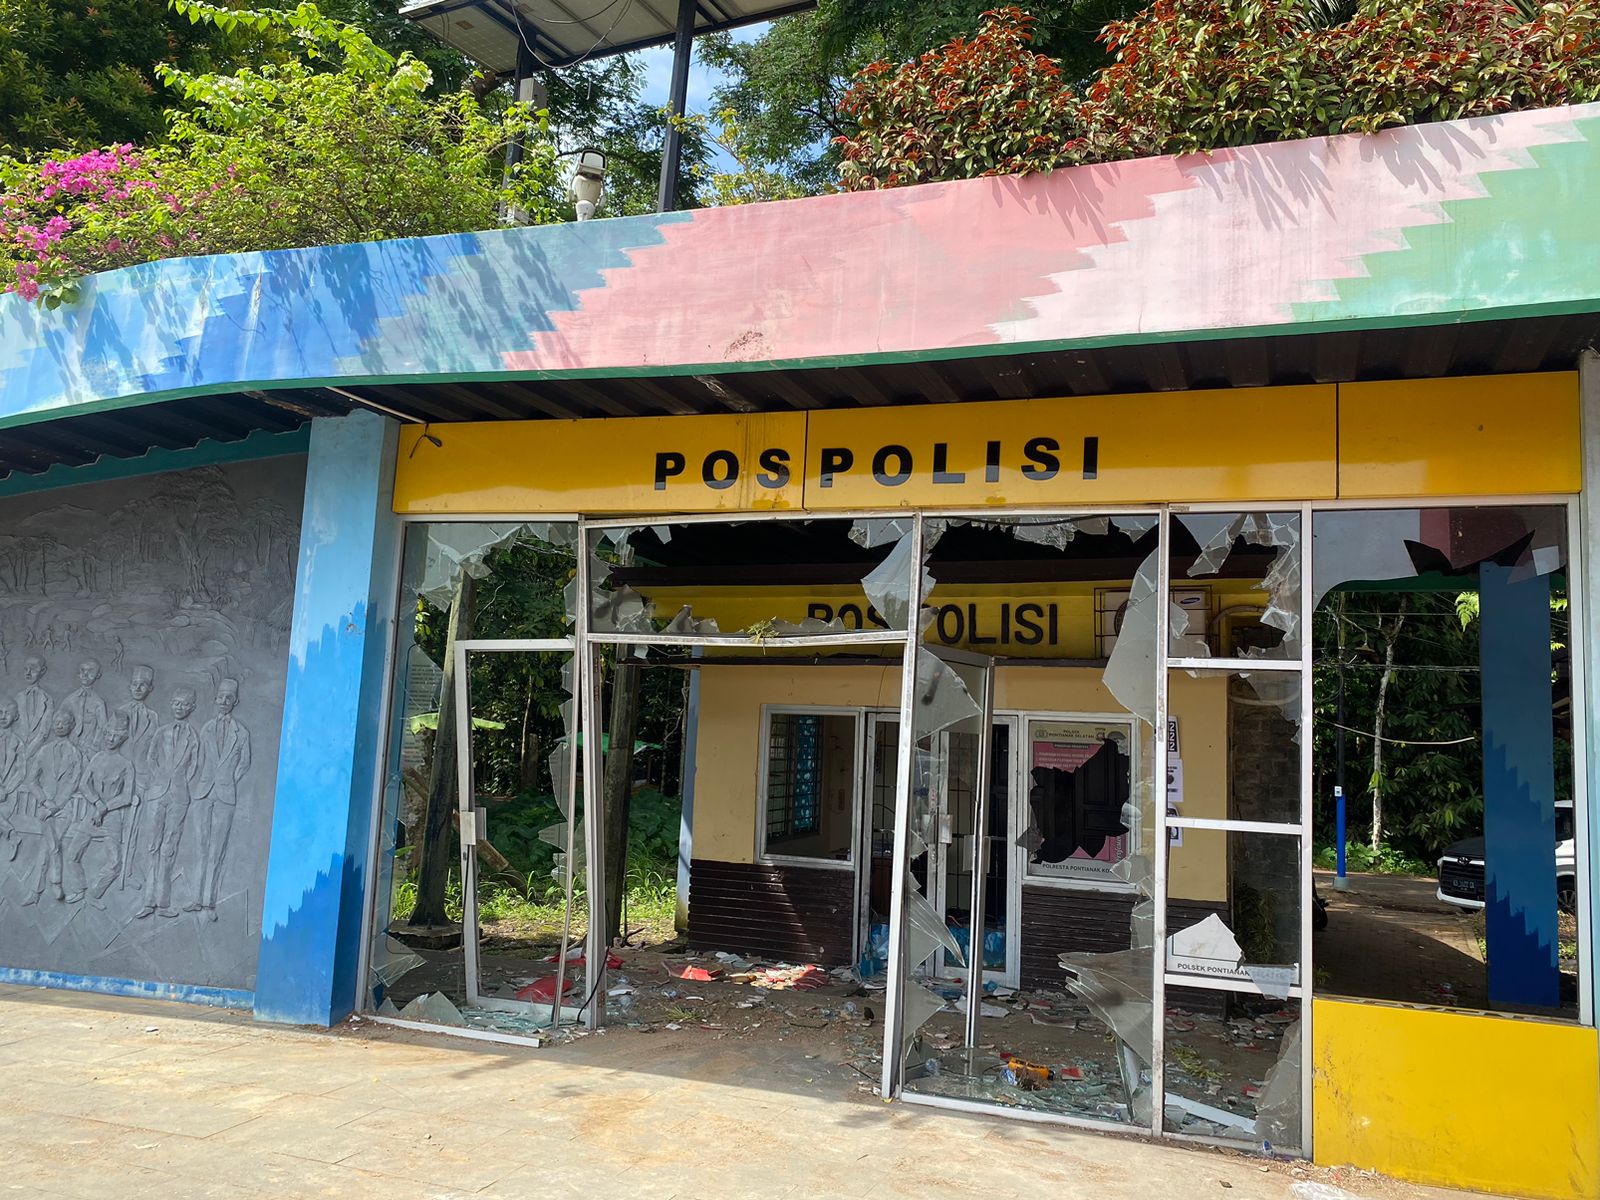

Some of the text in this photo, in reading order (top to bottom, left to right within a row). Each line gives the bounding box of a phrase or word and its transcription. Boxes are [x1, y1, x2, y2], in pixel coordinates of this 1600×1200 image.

[653, 436, 1099, 492] POS POLISI
[921, 603, 1057, 645] OLISI
[1177, 963, 1206, 972] POLSEK
